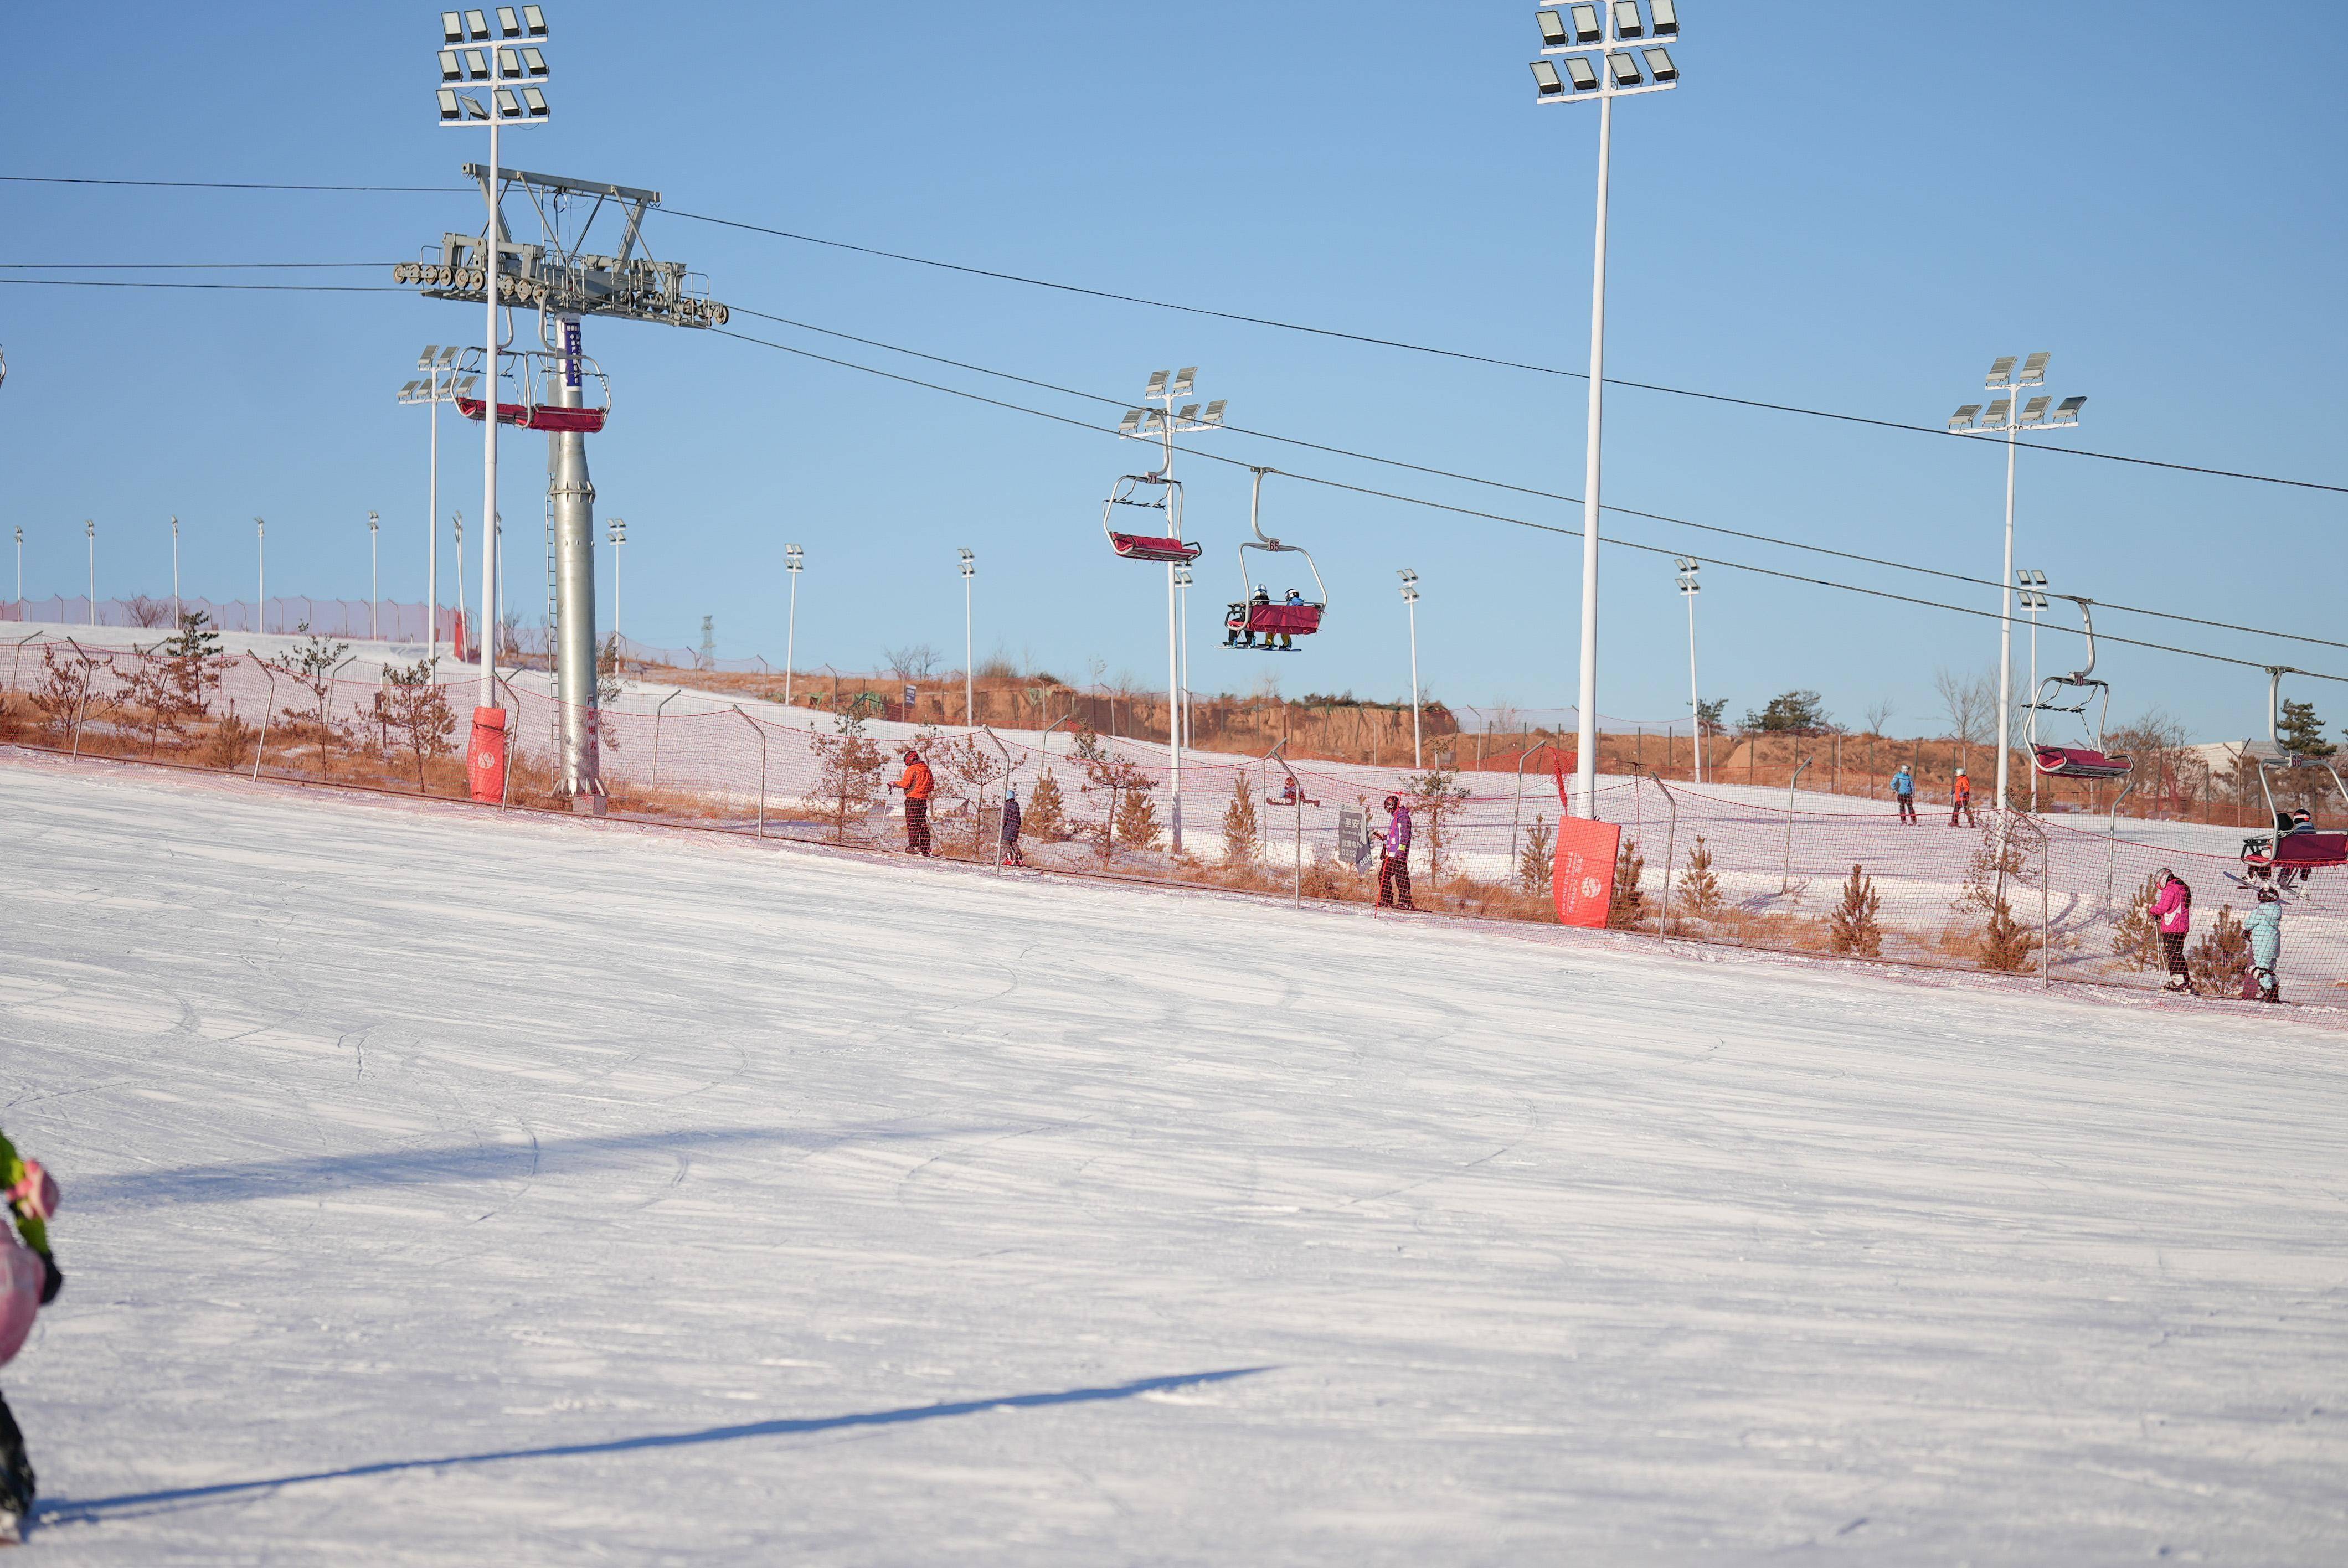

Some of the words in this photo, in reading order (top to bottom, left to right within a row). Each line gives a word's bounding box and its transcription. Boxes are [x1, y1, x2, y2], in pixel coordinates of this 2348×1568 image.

[1148, 475, 1157, 484] 71
[1270, 541, 1279, 551] 65
[2292, 755, 2301, 767] 66
[1342, 848, 1357, 857] 0352
